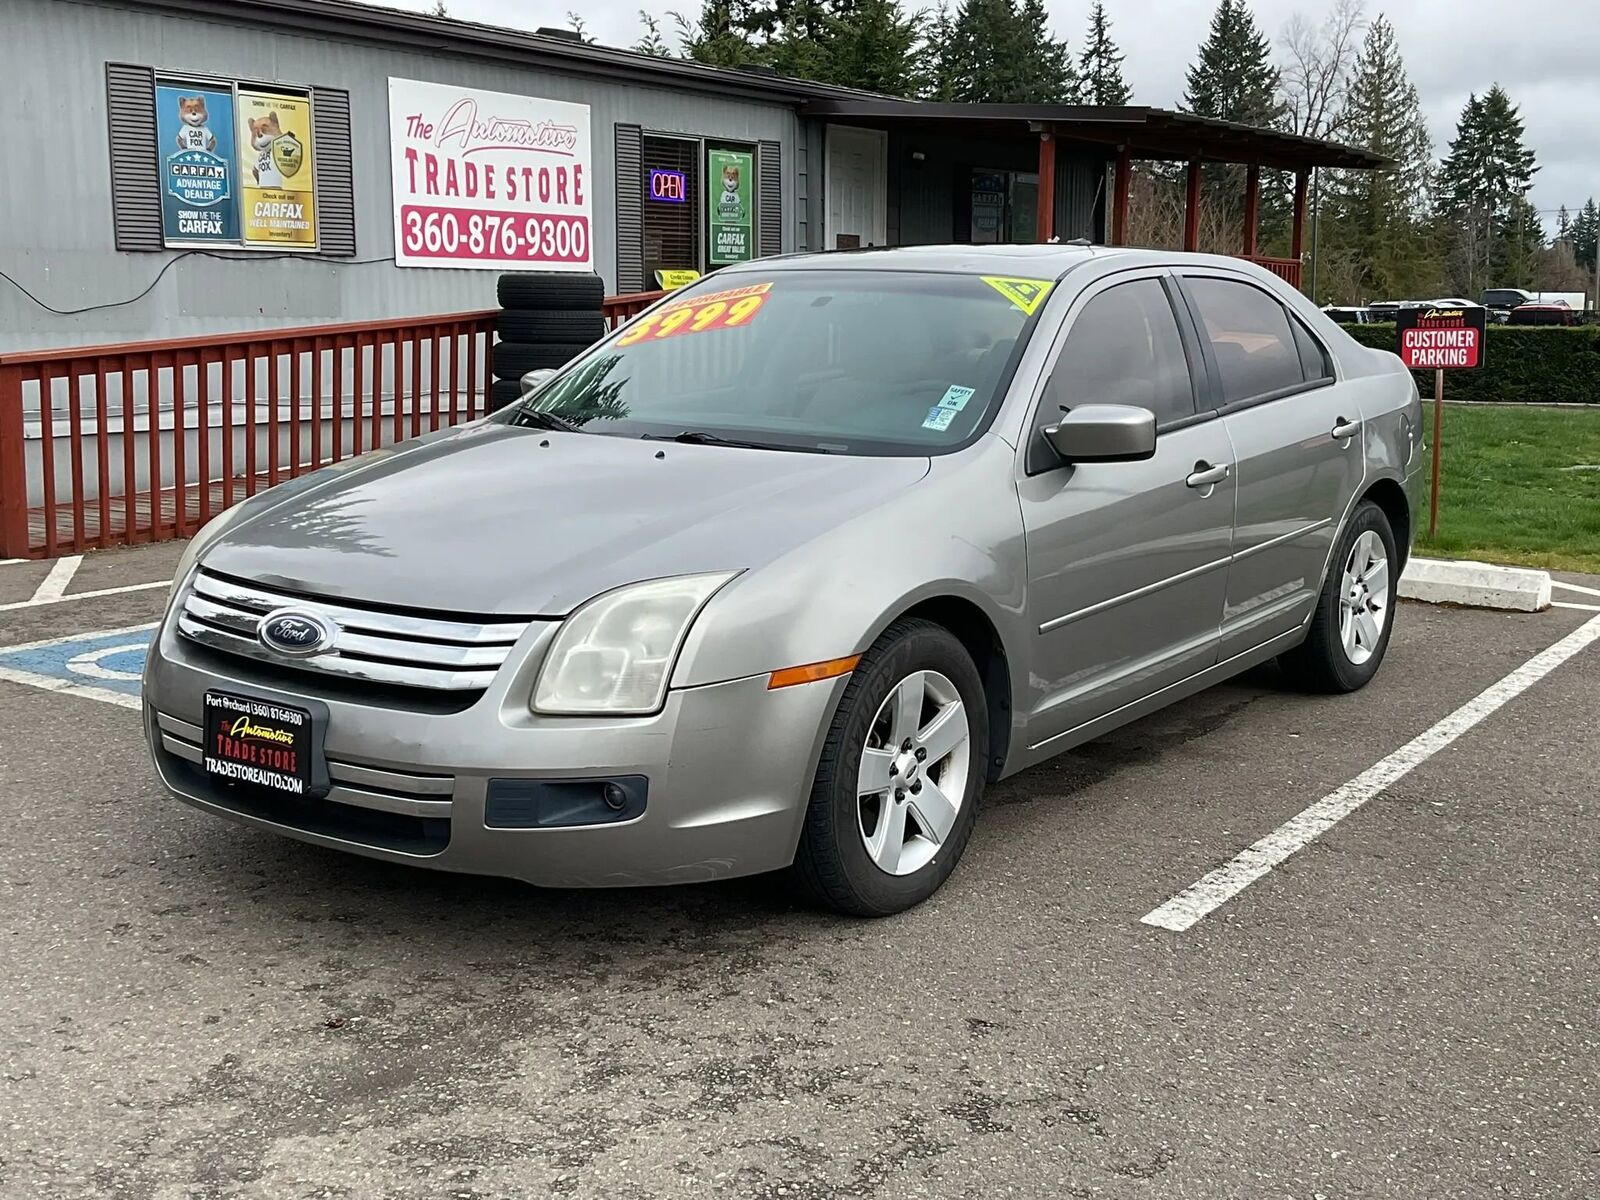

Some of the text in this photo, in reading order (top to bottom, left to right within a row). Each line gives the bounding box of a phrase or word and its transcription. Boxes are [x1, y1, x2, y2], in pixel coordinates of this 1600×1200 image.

[406, 98, 577, 149] The Automotive
[189, 130, 203, 138] CAR
[190, 138, 203, 146] FOX
[172, 165, 222, 178] CARFAX
[405, 147, 584, 206] TRADE STORE
[176, 179, 221, 190] ADVANTAGE
[653, 173, 684, 199] OPEN
[185, 190, 214, 199] DEALER
[178, 210, 221, 221] SHOW ME THE
[254, 201, 304, 219] CARFAX
[179, 220, 222, 234] CARFAX
[250, 219, 310, 230] WELL MAINTAINED
[406, 210, 585, 258] 360-876-9300
[717, 232, 745, 245] CARFAX
[1405, 331, 1474, 347] CUSTOMER
[1411, 349, 1467, 365] PARKING
[950, 387, 972, 396] SAFETY
[274, 619, 309, 641] Ford
[206, 694, 222, 707] Port
[222, 697, 250, 713] Orchard
[251, 703, 269, 718] (360)
[230, 716, 294, 744] Automotive
[217, 734, 296, 772] TRADE STORE
[205, 757, 302, 794] TRADESTOREAUTO.COM
